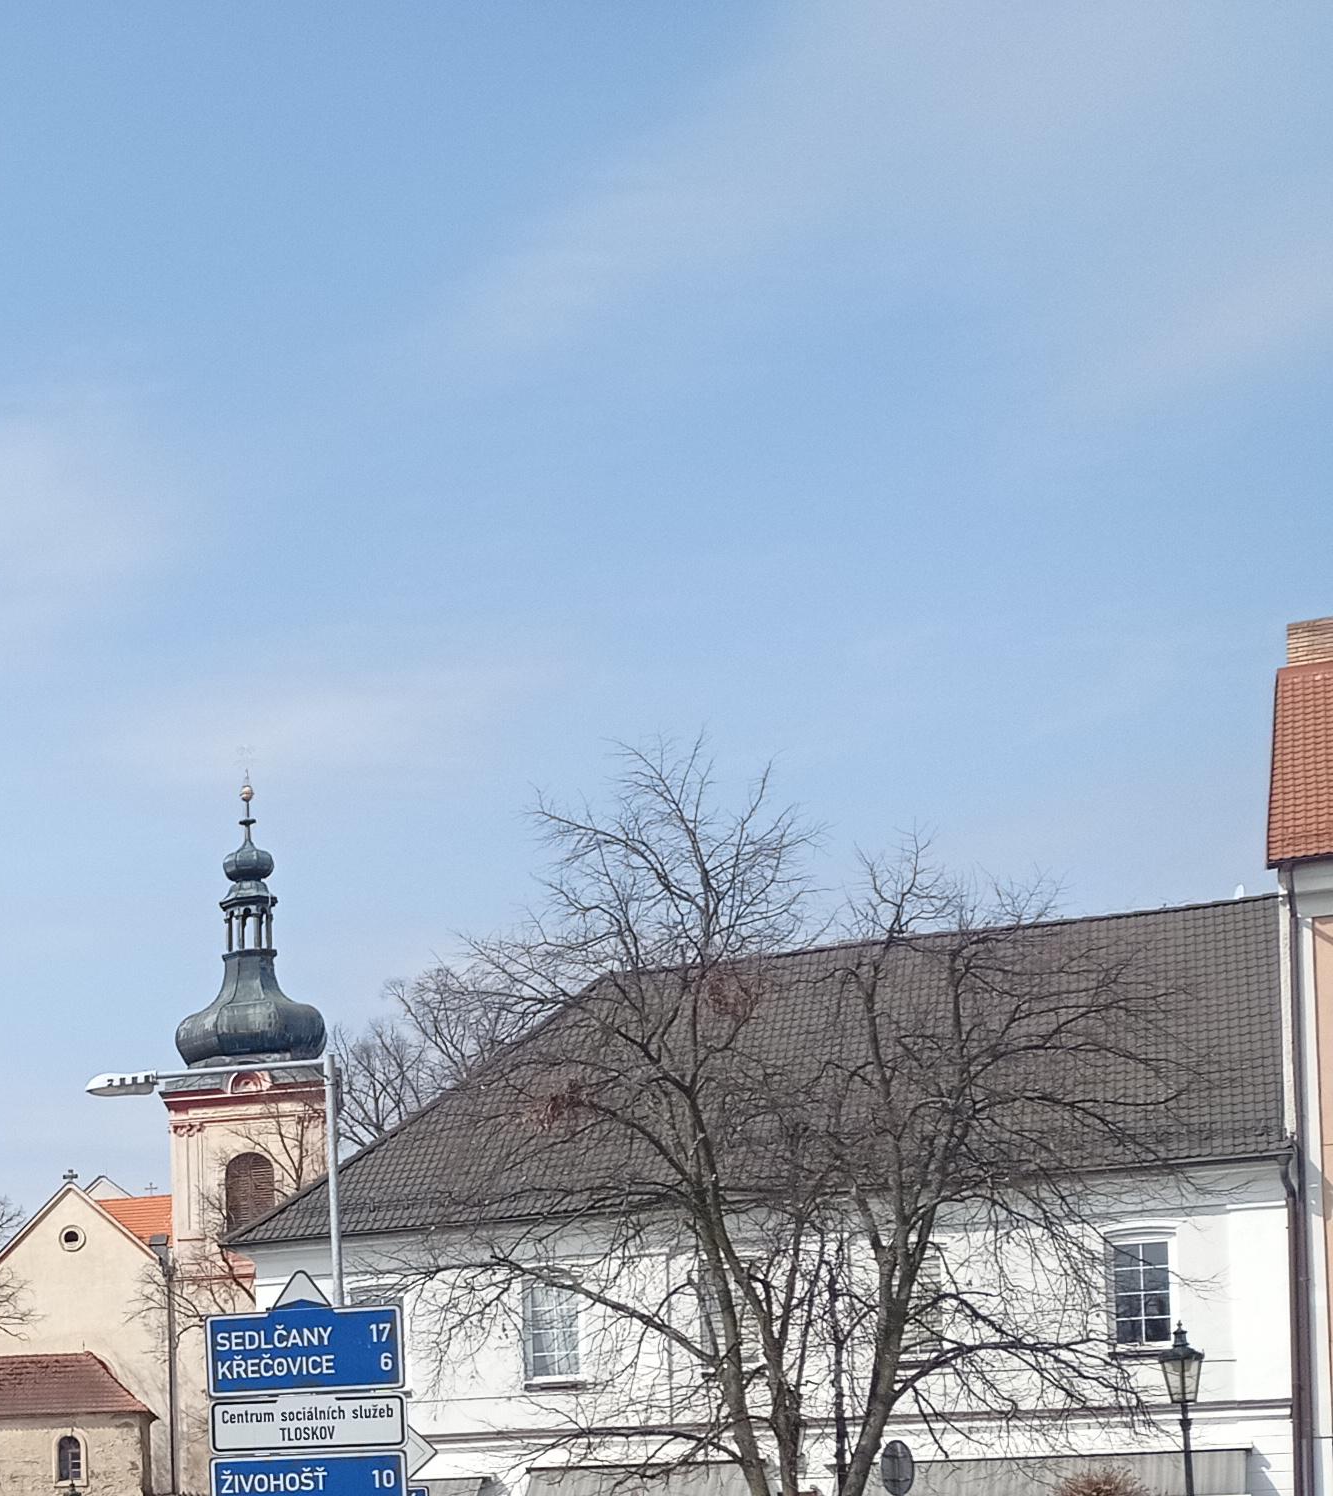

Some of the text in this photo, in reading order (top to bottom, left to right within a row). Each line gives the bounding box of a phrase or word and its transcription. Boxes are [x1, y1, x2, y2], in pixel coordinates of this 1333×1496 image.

[216, 1323, 391, 1351] SEDLČANY 17
[217, 1353, 393, 1379] KŘEČOVICE 6
[221, 1404, 394, 1424] Centrum sociálních služeb
[279, 1426, 335, 1442] TLOSKOV
[220, 1466, 395, 1494] ŽIVOHOŠŤ 10
